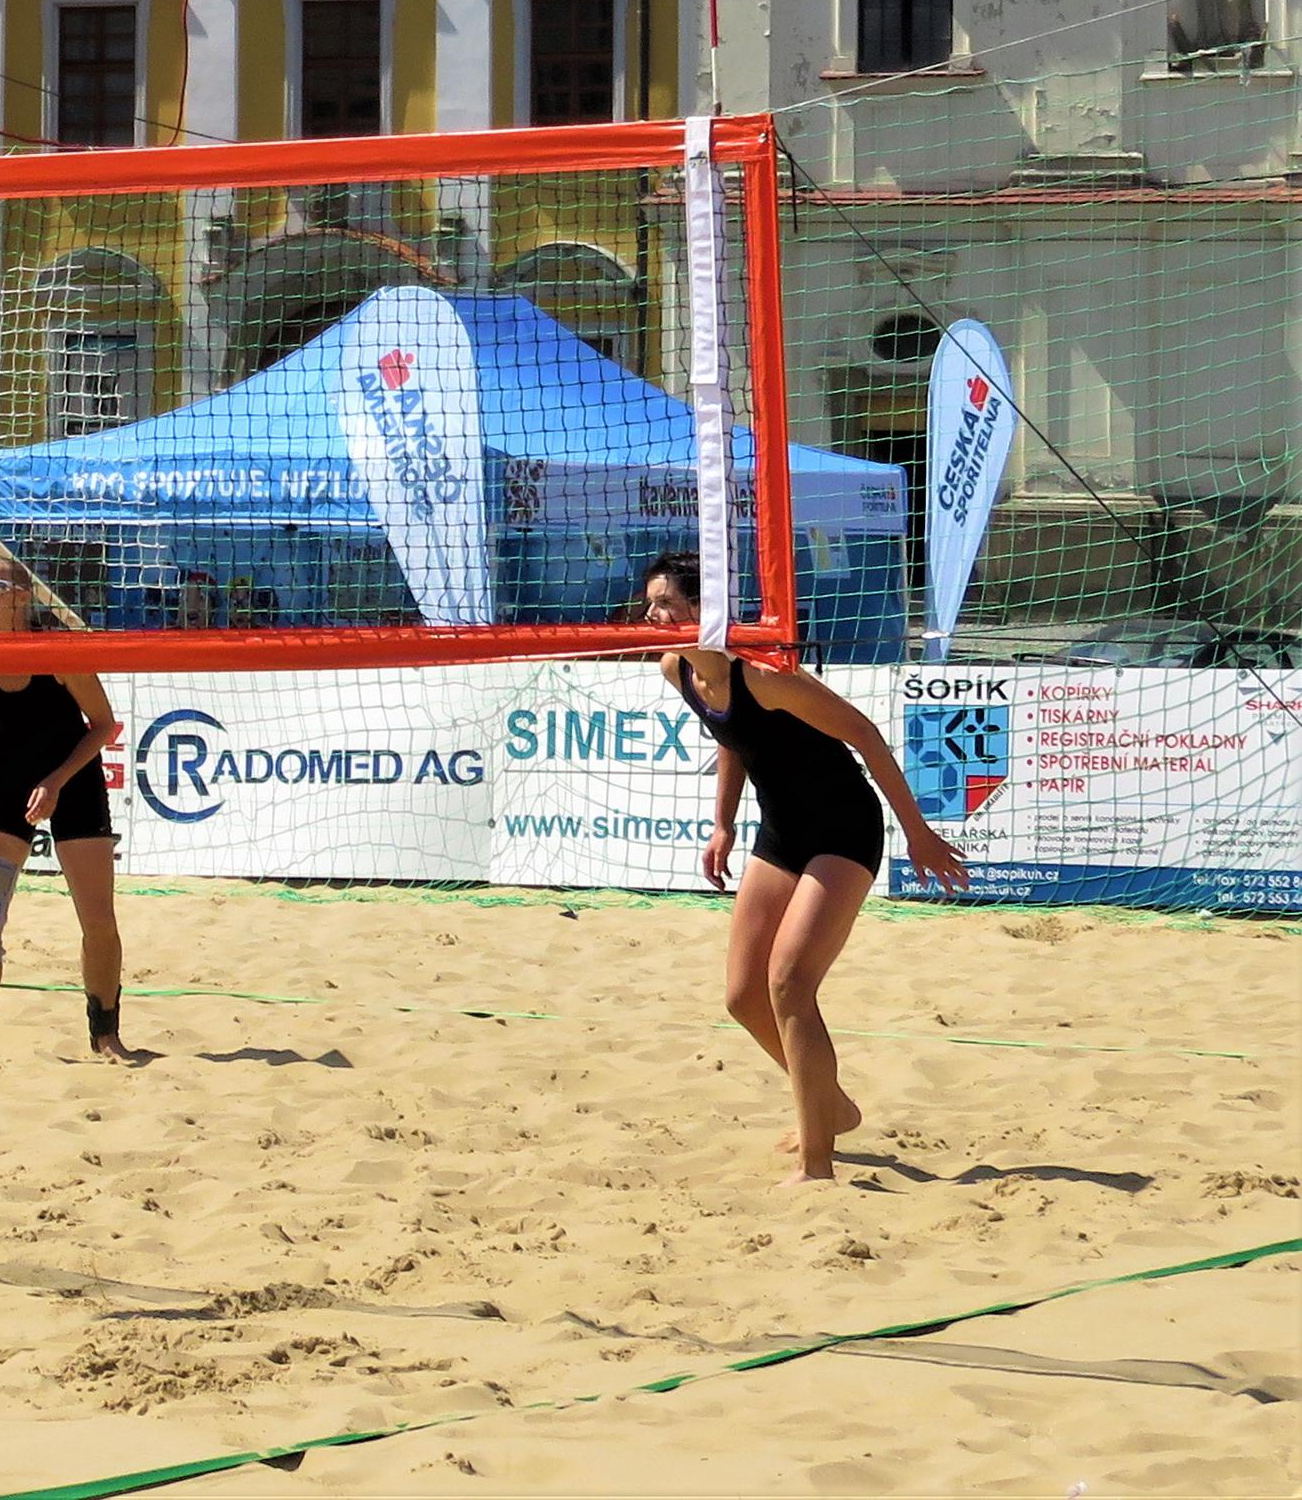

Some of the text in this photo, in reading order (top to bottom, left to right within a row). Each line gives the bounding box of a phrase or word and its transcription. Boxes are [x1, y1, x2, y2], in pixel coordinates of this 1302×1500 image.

[938, 405, 980, 512] ČESKÁ
[904, 674, 1008, 700] ŠOPÍK
[1040, 682, 1113, 702] KOPÍRKY
[1040, 707, 1120, 725] TISKÁRNY
[506, 710, 691, 762] SIMEX
[1040, 729, 1248, 750] REGISTRAČNÍ POKLADNY
[168, 734, 484, 796] RADOMED AG
[1039, 752, 1215, 773] SPOTŘEBNÍ MATERIÁL
[1039, 776, 1086, 794] PAPÍR
[1268, 875, 1290, 888] 552
